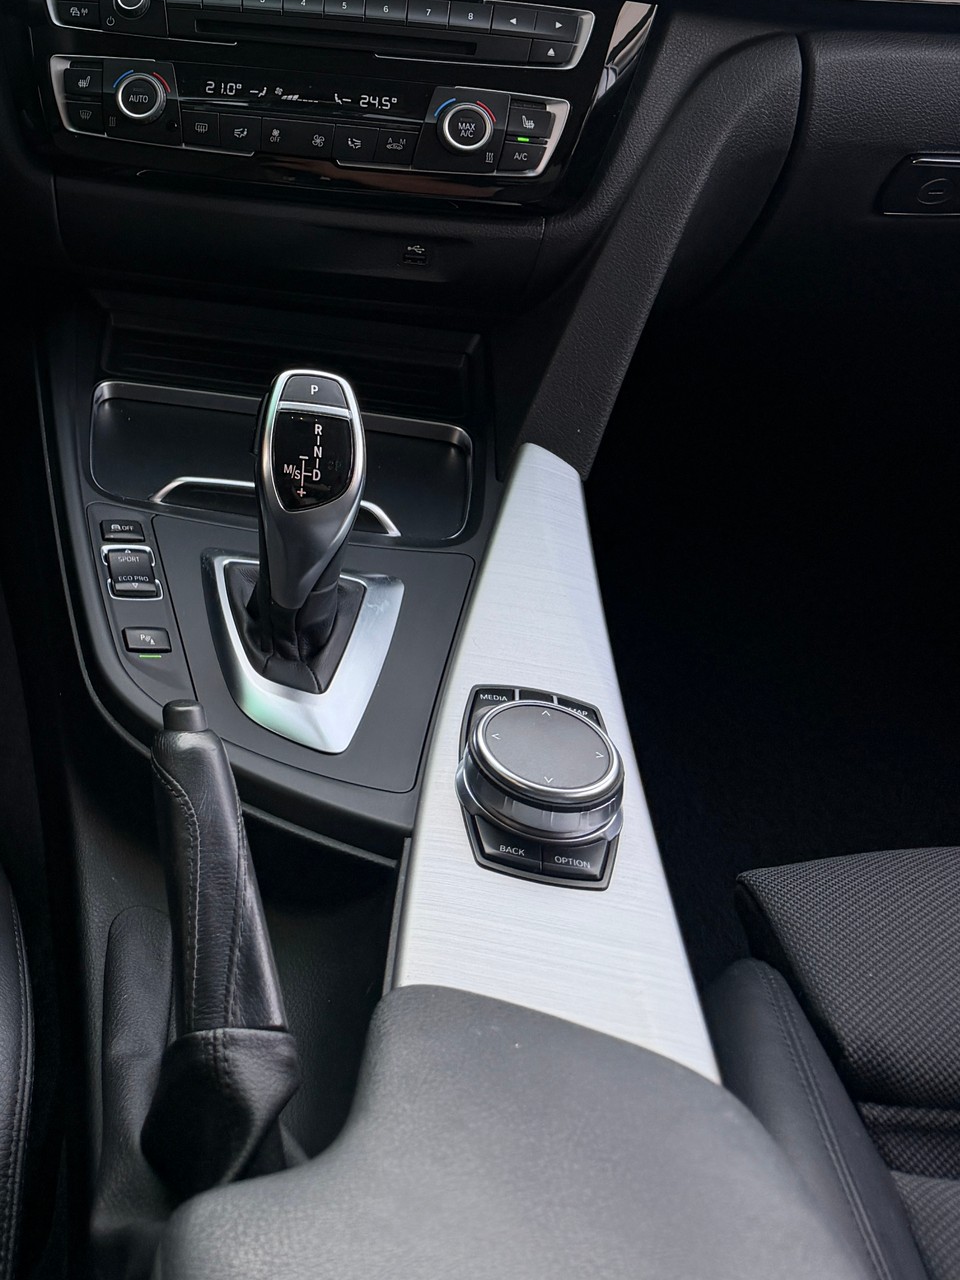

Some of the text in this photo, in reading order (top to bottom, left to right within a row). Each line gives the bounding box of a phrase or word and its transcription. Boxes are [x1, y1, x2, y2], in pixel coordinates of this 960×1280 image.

[342, 1, 347, 10] 5
[383, 5, 389, 13] 6
[426, 8, 431, 16] 7
[467, 12, 473, 20] 8
[128, 94, 149, 103] AUTO
[458, 122, 475, 130] MAX
[460, 129, 474, 138] A/C
[513, 151, 528, 161] A/C
[310, 384, 319, 395] P
[314, 424, 323, 436] R
[313, 446, 322, 458] N
[312, 469, 321, 481] D
[499, 844, 525, 856] BACK
[554, 855, 591, 868] OPTION
